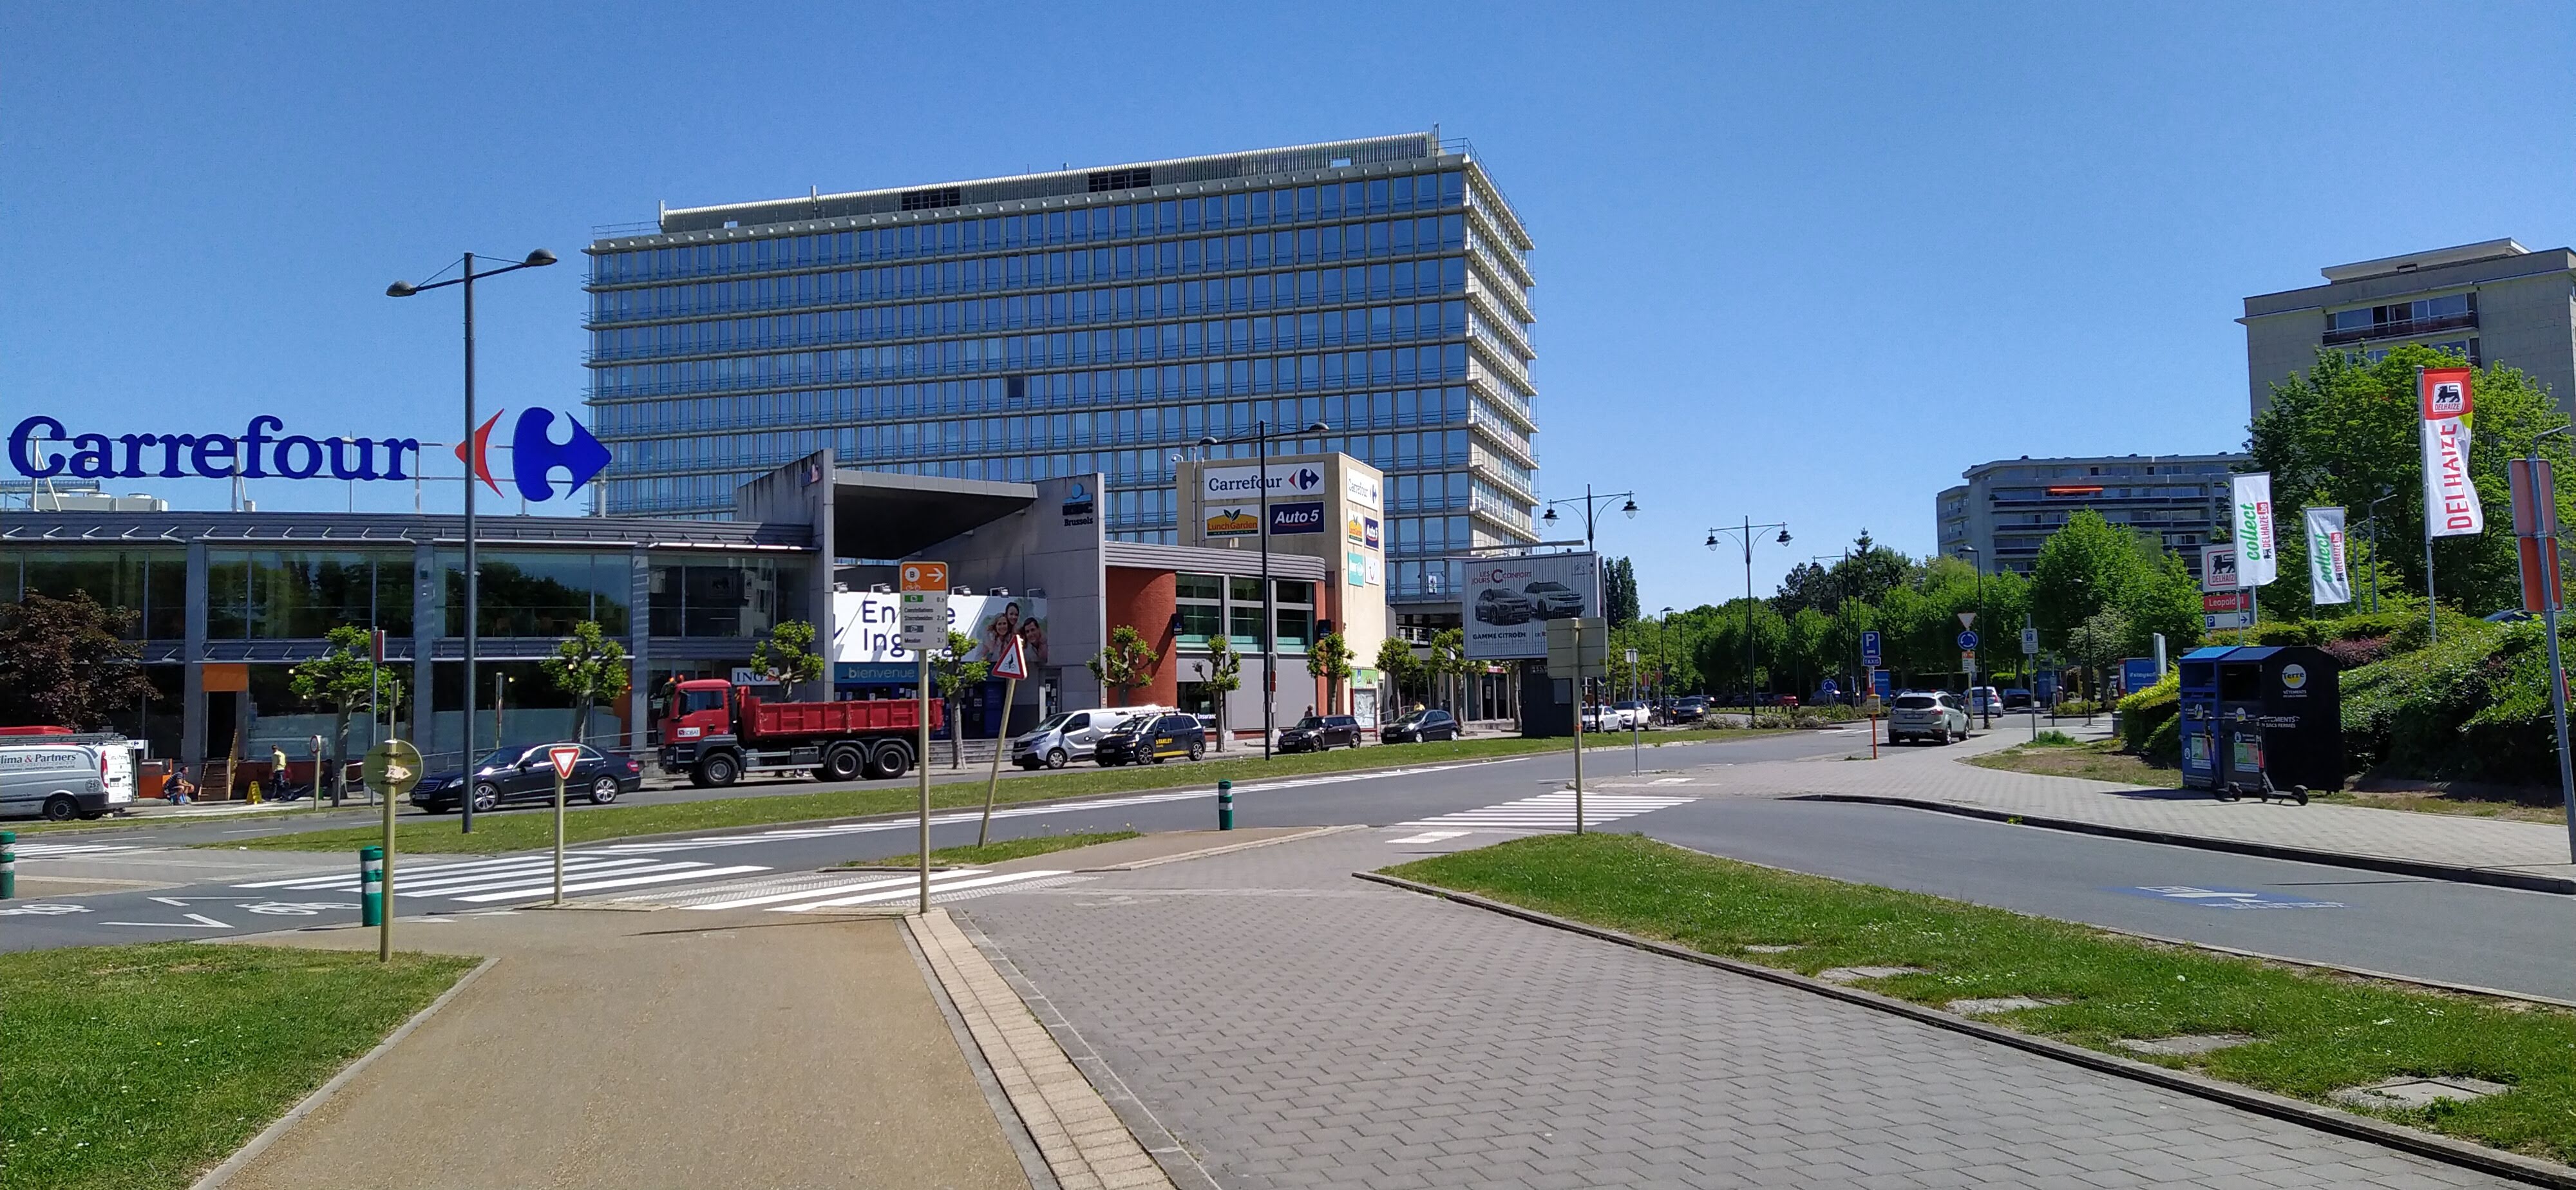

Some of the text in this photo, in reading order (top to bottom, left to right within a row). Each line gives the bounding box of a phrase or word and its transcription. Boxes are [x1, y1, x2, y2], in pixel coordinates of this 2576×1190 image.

[8, 415, 419, 480] Carrefour
[2440, 423, 2473, 529] DELHAIZE
[1064, 516, 1094, 526] Brussels
[1274, 509, 1320, 524] Auto 5
[2239, 502, 2260, 562] collect
[2314, 533, 2333, 583] collect
[2212, 574, 2236, 583] DELHAIZ
[2209, 597, 2236, 607] Leopold
[2208, 616, 2213, 625] P
[1866, 634, 1875, 647] P
[736, 672, 764, 683] ING
[849, 666, 915, 679] bienvenue
[0, 755, 23, 764] lima
[24, 754, 33, 763] &
[35, 753, 77, 762] Partners
